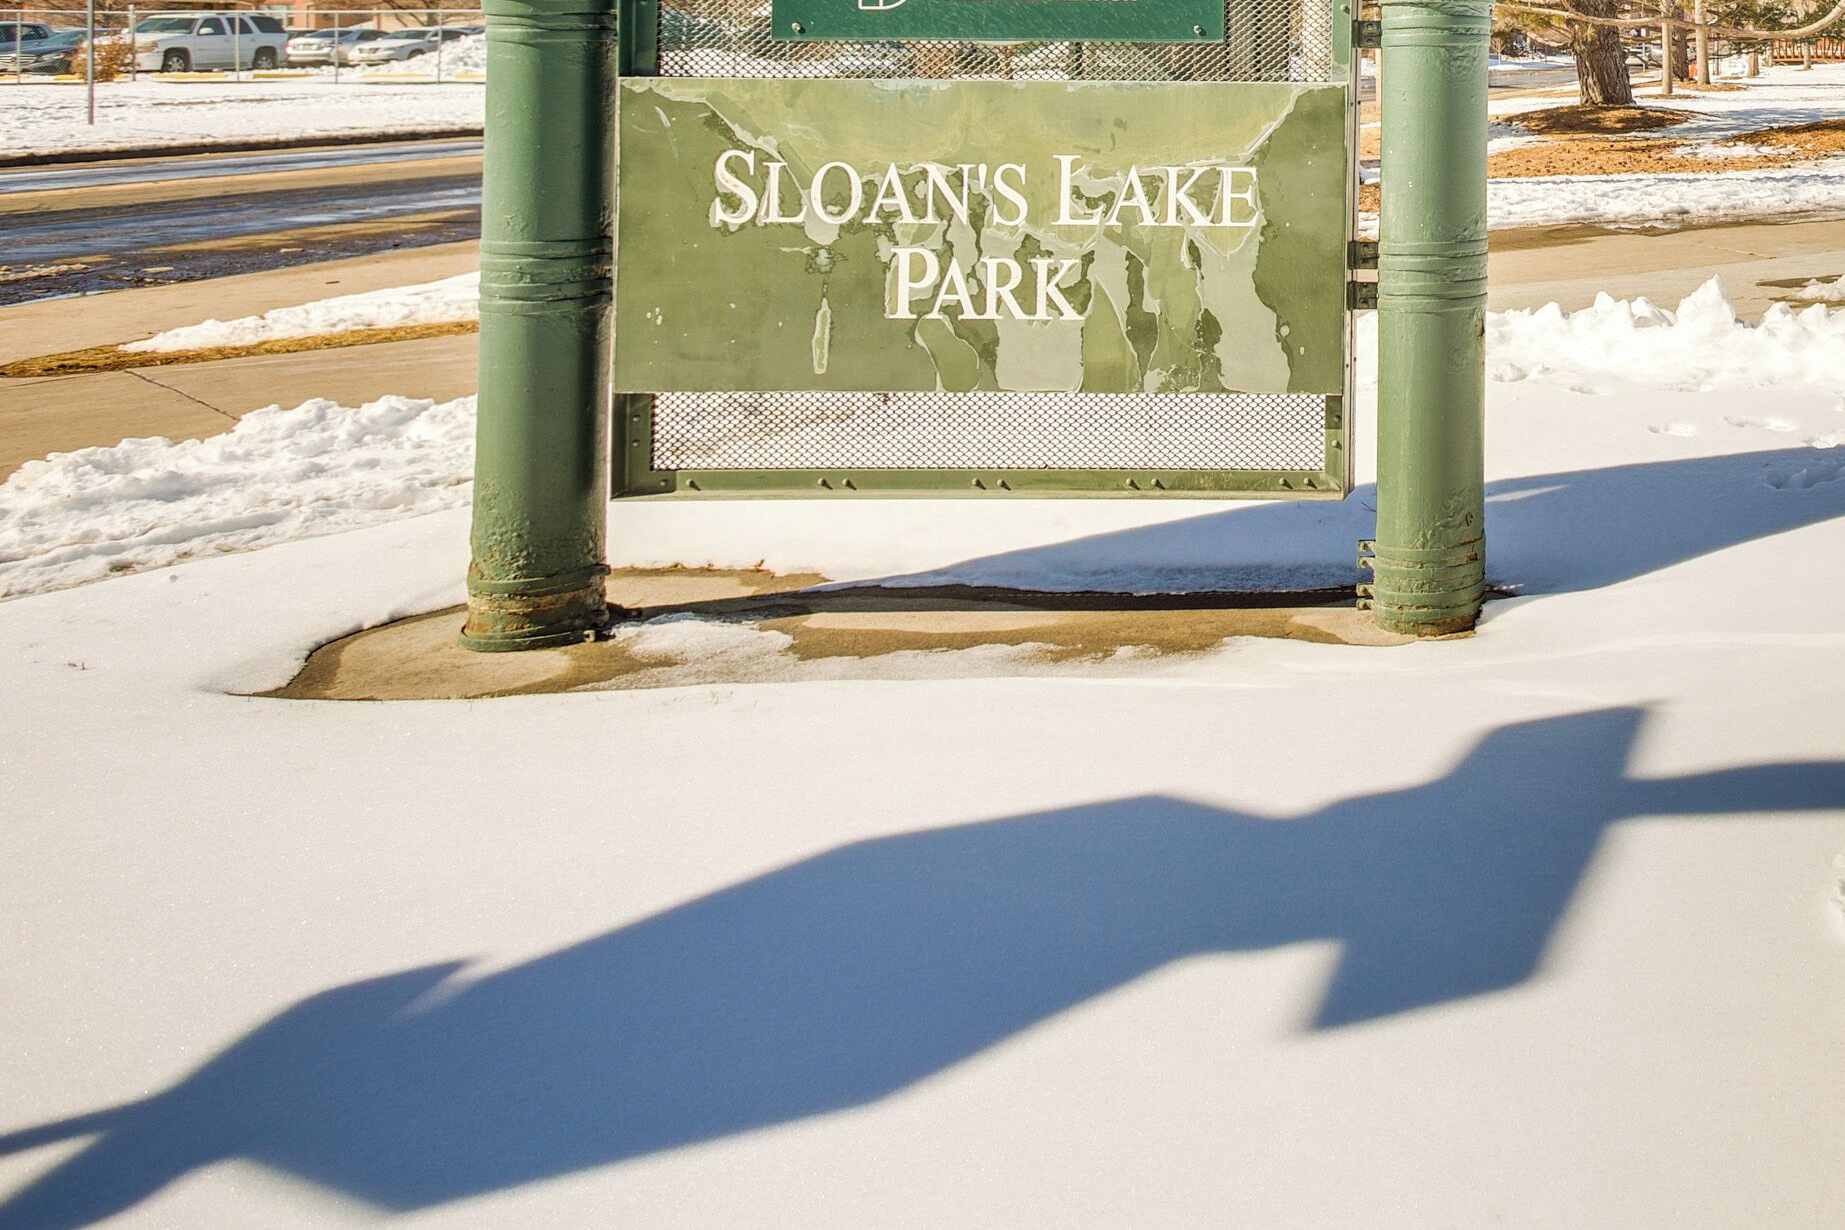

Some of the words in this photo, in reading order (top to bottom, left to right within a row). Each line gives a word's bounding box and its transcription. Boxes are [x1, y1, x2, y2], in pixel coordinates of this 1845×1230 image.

[714, 149, 1029, 226] SLOAN'S
[1051, 154, 1260, 227] LAKE
[888, 247, 1085, 321] PARK
